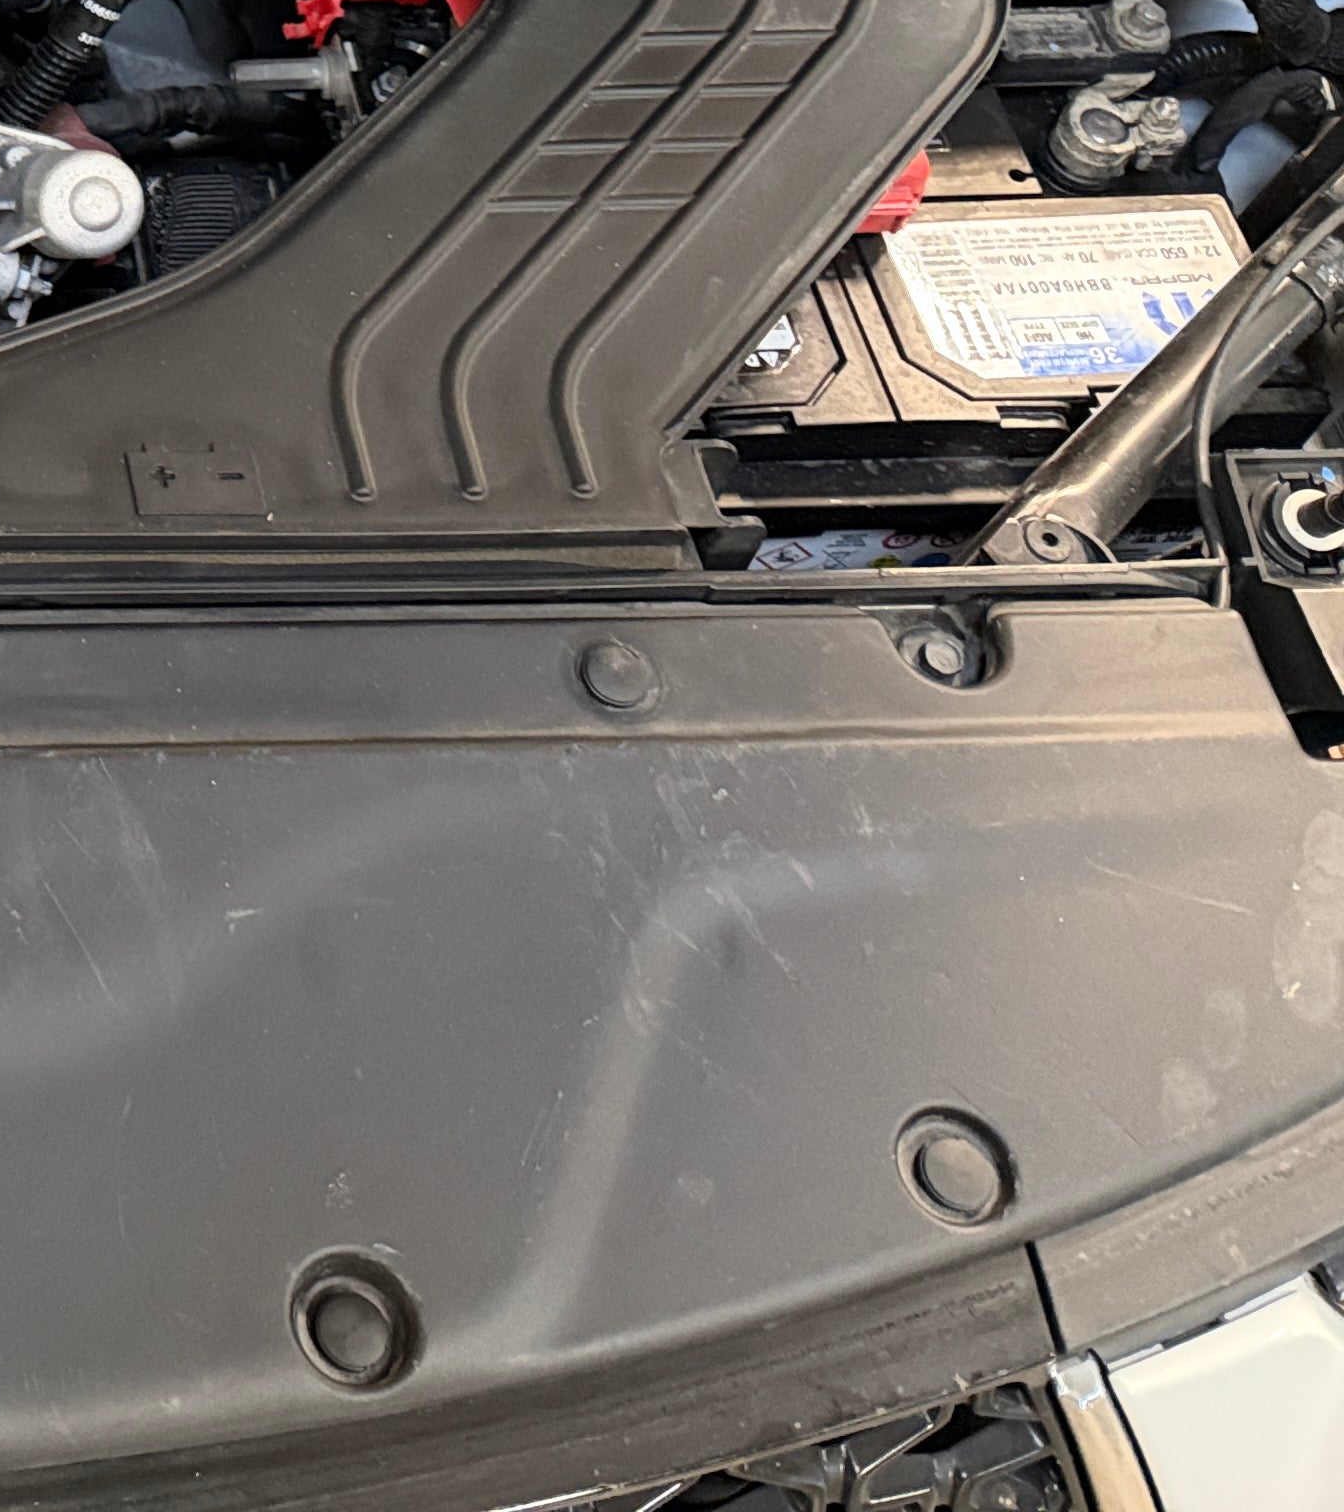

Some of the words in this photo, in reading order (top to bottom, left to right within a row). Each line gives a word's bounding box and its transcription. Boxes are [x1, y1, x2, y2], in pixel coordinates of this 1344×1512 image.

[1011, 253, 1036, 266] 100
[1078, 251, 1099, 264] 70
[1160, 246, 1189, 260] 650
[1089, 345, 1125, 365] 36
